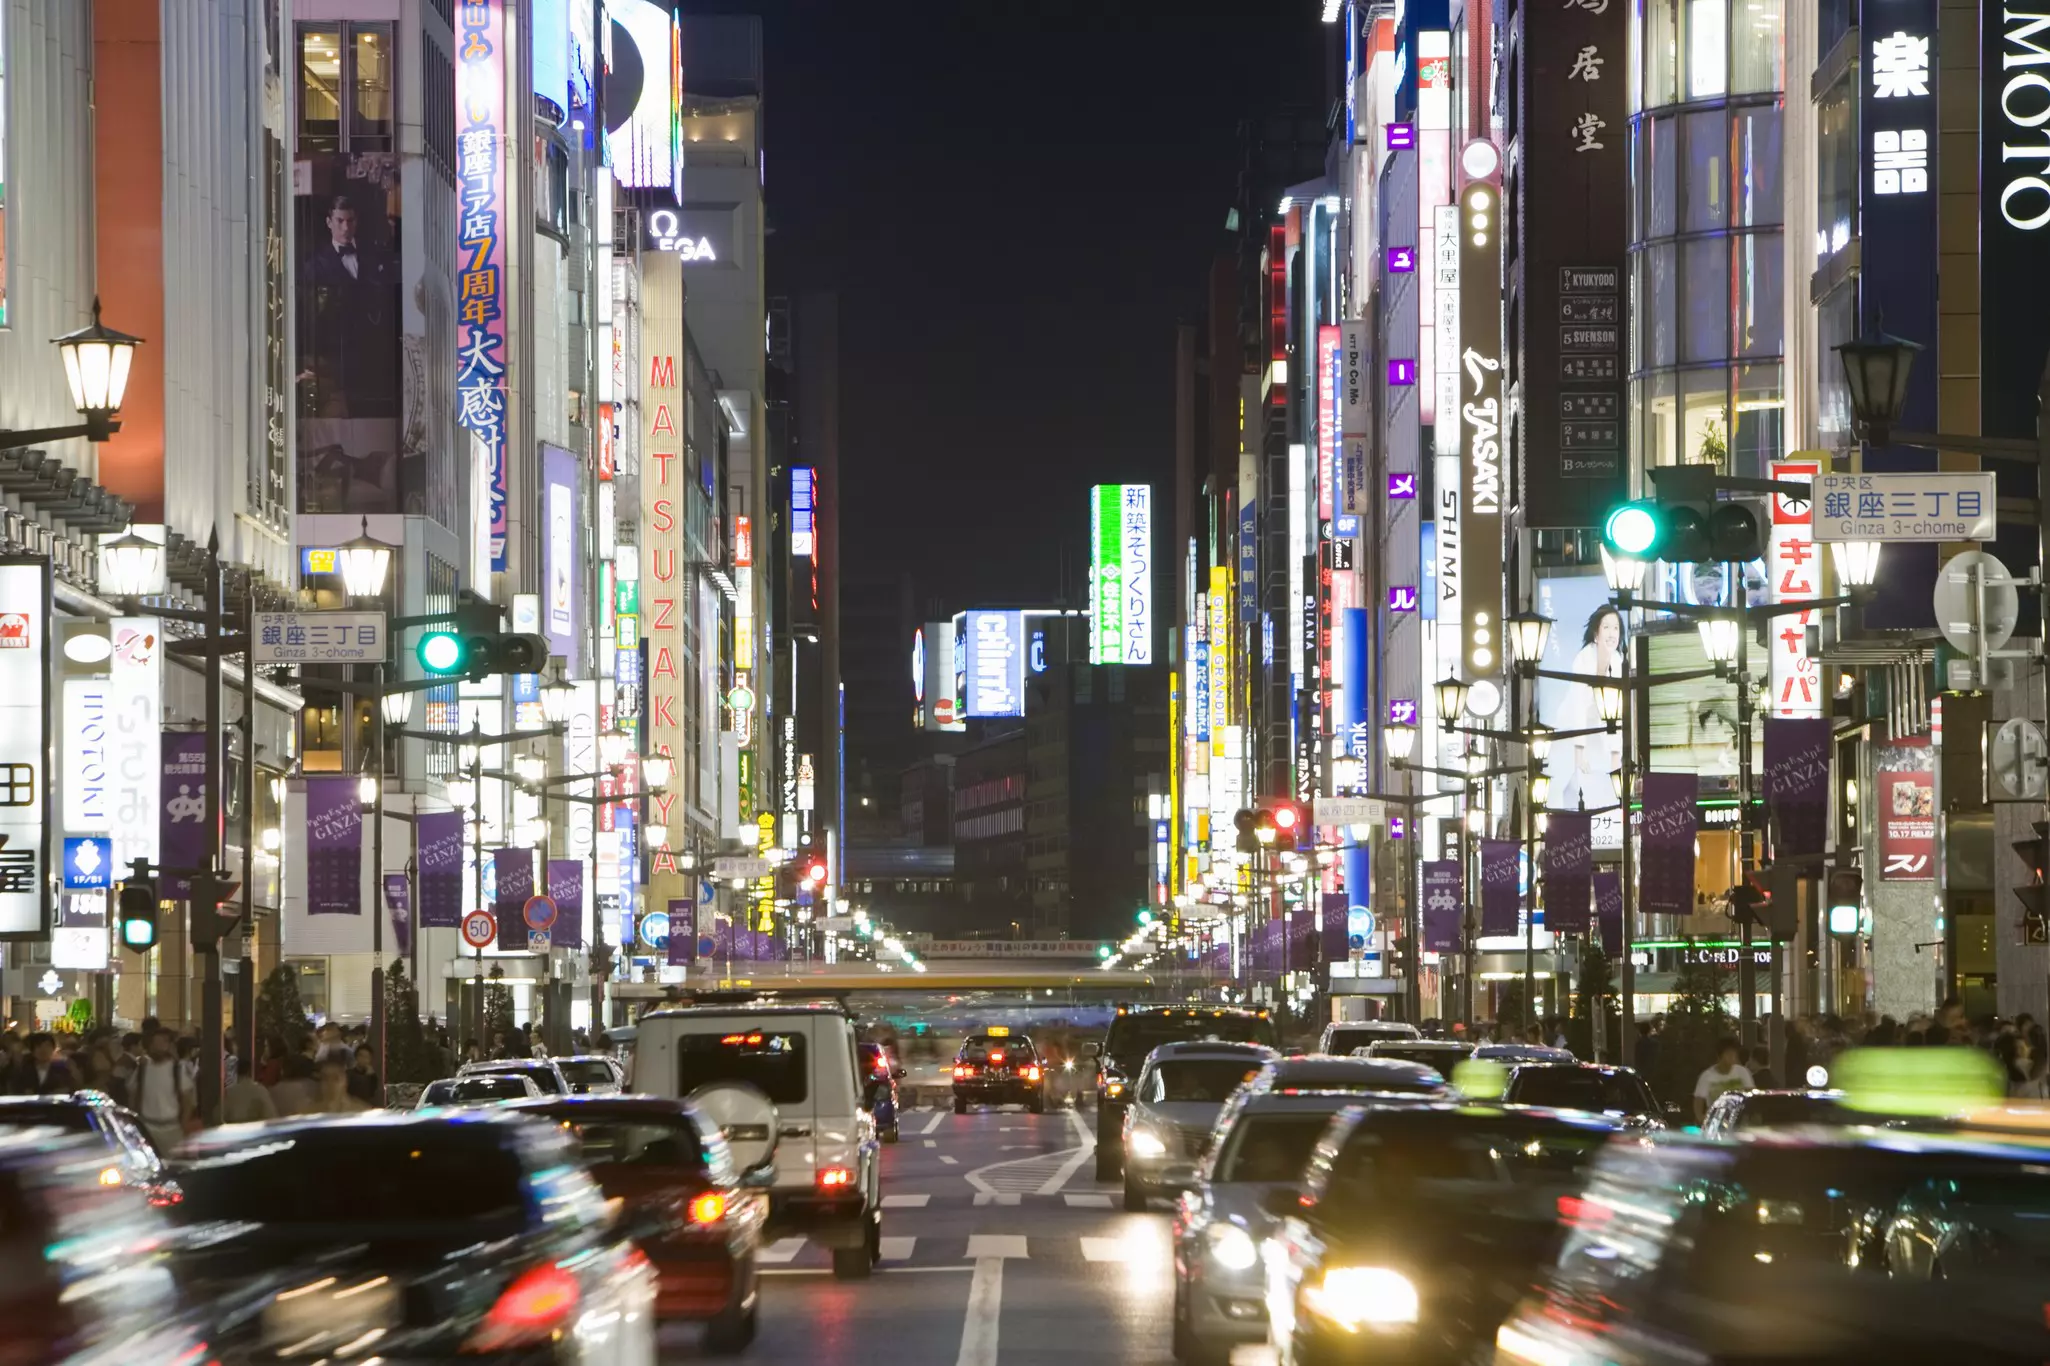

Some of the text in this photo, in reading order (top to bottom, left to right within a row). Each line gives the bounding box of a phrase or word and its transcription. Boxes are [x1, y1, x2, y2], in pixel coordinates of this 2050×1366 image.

[1873, 32, 1929, 194] 楽器
[461, 130, 492, 238] 銀座コア店
[1440, 232, 1457, 283] 大黒屋
[461, 238, 495, 325] 7周年
[1573, 273, 1614, 288] KYUKYODO
[1563, 303, 1571, 316] 6
[1573, 331, 1615, 343] SVENSON
[1564, 362, 1573, 375] 4
[1564, 400, 1573, 412] 3
[1463, 398, 1498, 514] TASAKI
[1823, 476, 1873, 490] 中央区
[1824, 491, 1982, 519] 銀座三丁目
[1840, 520, 1967, 537] Ginza 3-chome
[1442, 489, 1458, 602] SHIMA
[1242, 519, 1255, 608] 名鉄観光
[261, 614, 297, 624] 中央区
[650, 355, 678, 875] MATSUZAKAYA
[261, 626, 376, 646] 銀座三丁目
[1780, 538, 1818, 718] キムラヤのパ
[273, 647, 364, 660] Ginza 3-chome
[1213, 595, 1227, 728] GINZA GRANDIR
[1764, 743, 1824, 779] PROMENADE
[1772, 758, 1829, 796] GINZA
[307, 799, 357, 828] PROMENADE
[1641, 795, 1692, 825] PROMENADE
[315, 812, 362, 840] GINZA
[1648, 811, 1696, 837] GINZA
[419, 831, 461, 856] PROMENADE
[424, 843, 463, 867] GINZA
[1551, 845, 1591, 868] GINZA
[501, 874, 535, 897] GINZA
[1486, 864, 1521, 883] GINZA
[553, 883, 583, 902] GINZA
[469, 919, 489, 937] 50
